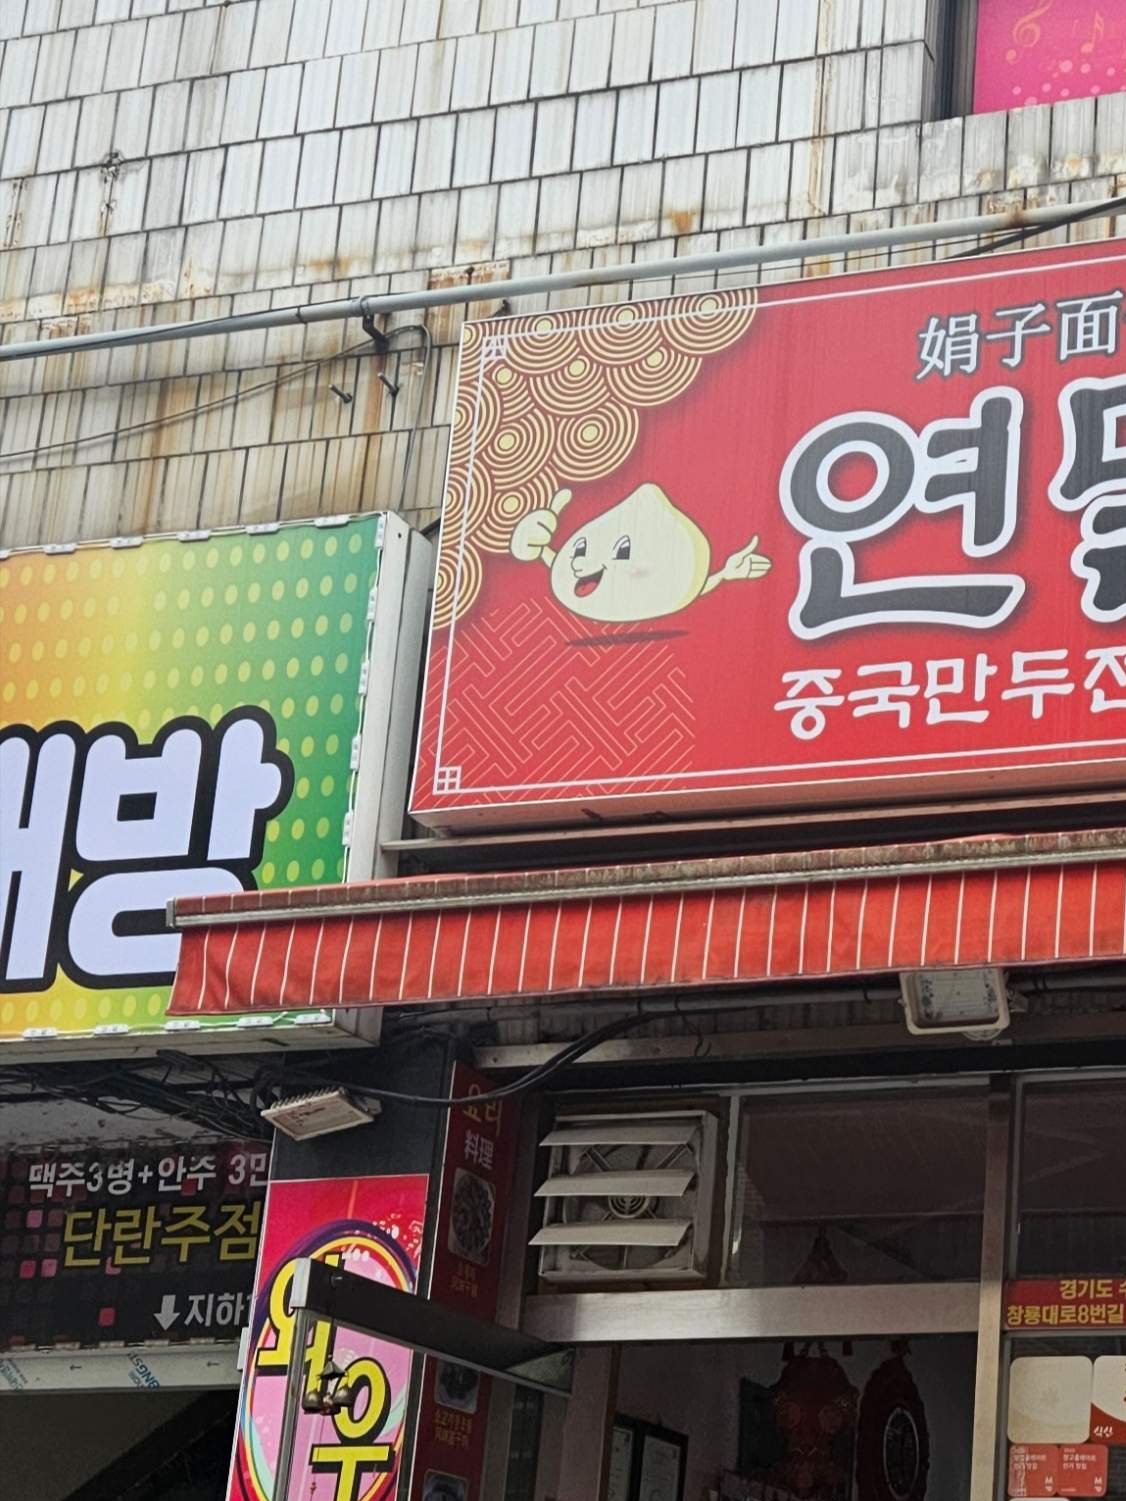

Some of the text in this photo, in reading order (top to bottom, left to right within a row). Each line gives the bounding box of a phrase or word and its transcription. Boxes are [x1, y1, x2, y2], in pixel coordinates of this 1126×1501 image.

[63, 1201, 262, 1267] 단란주점
[1060, 1279, 1114, 1299] 경기도
[1007, 1304, 1124, 1326] 창룡대로8번길
